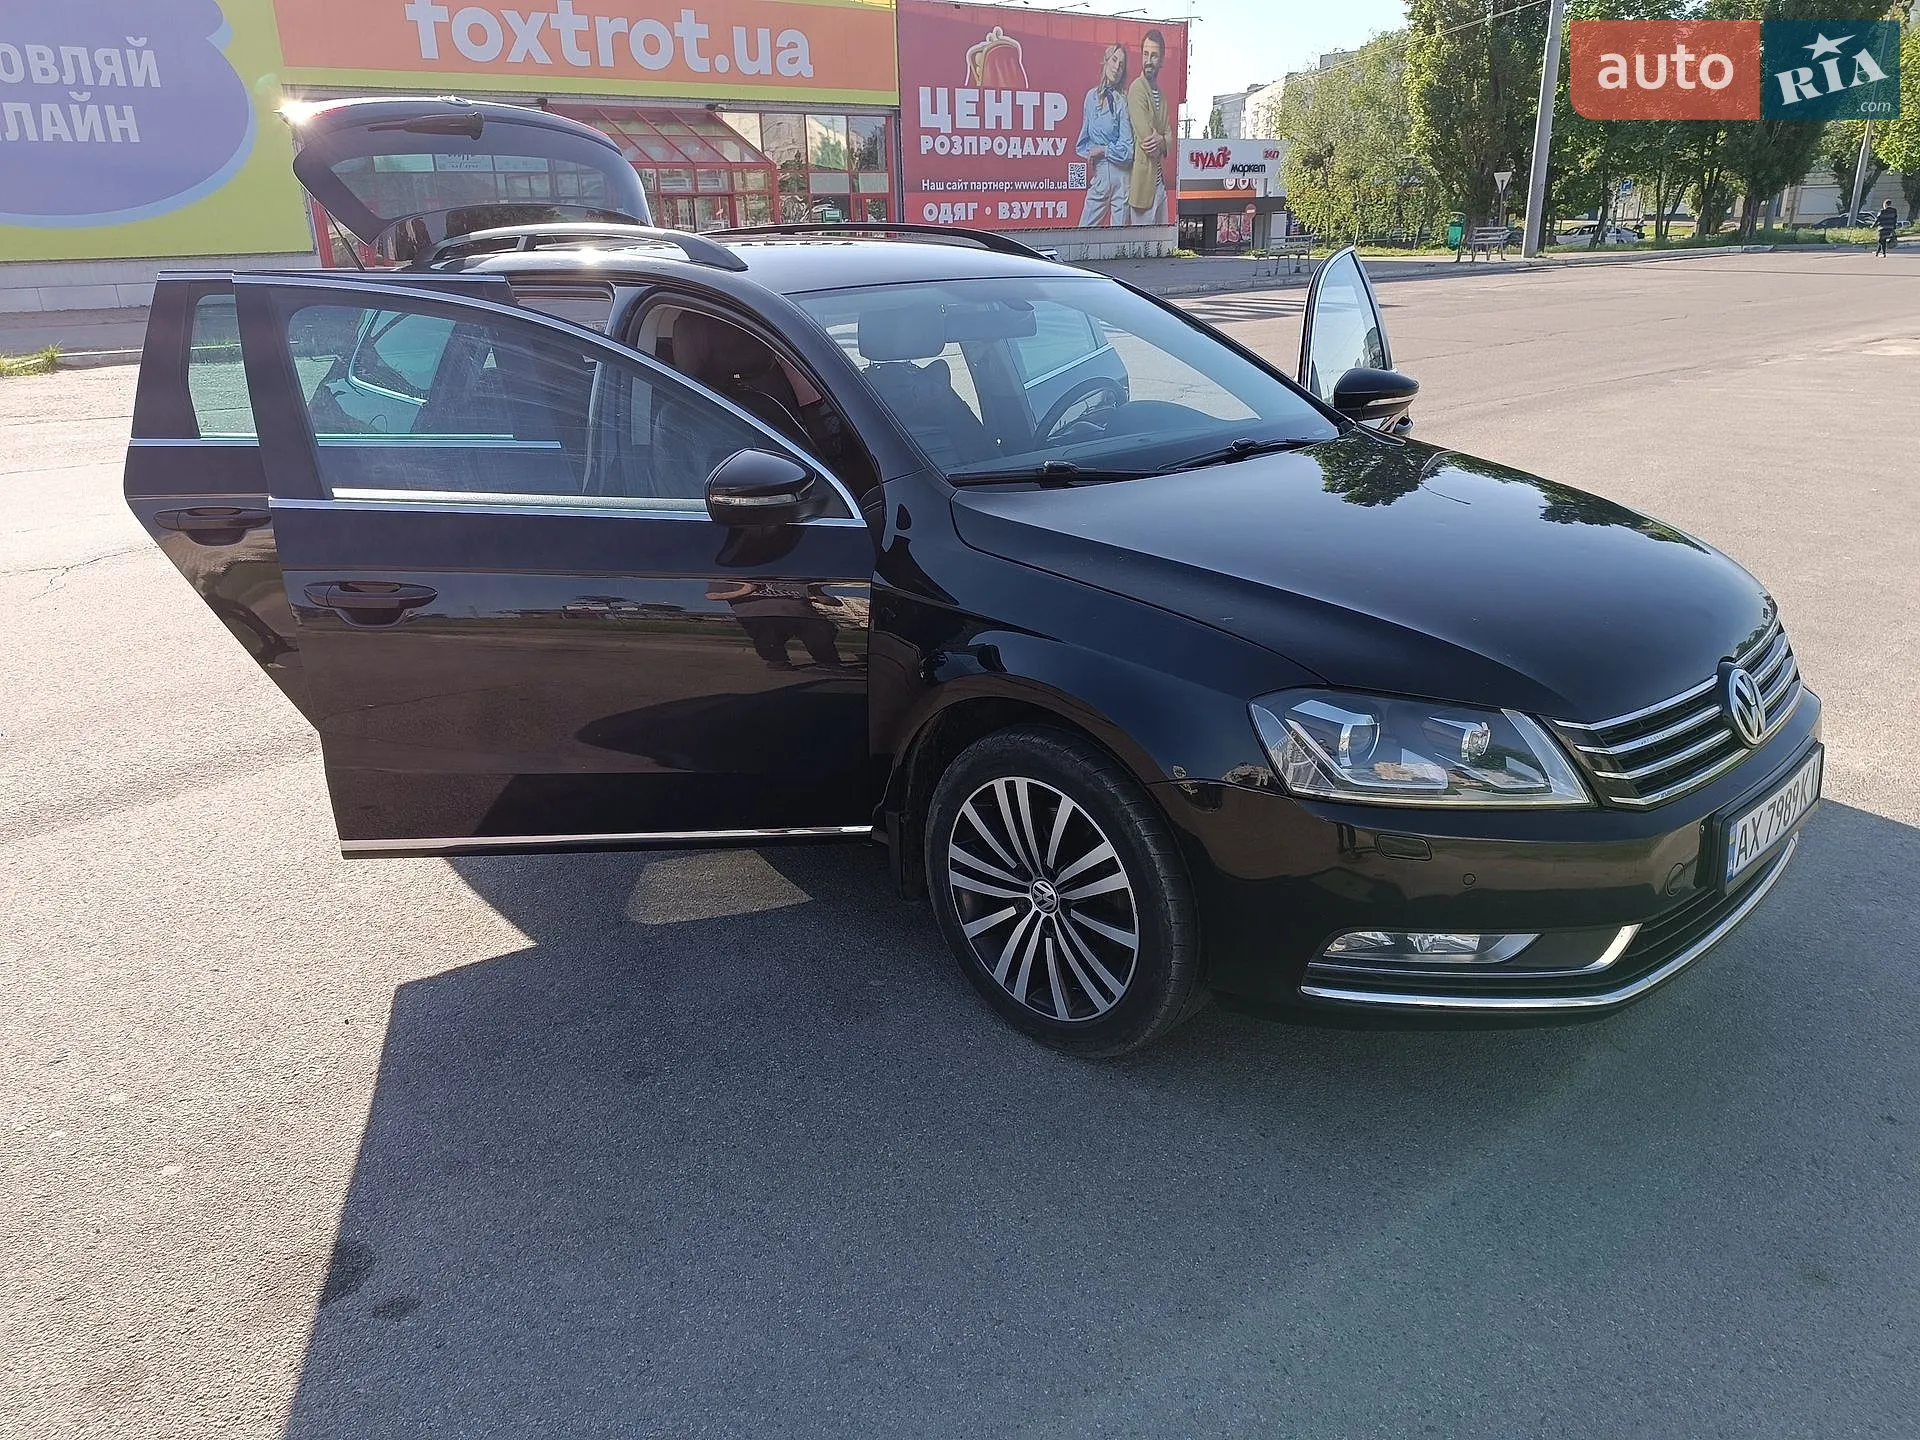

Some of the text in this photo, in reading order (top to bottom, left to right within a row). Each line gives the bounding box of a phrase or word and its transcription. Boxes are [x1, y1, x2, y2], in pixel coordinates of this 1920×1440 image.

[0, 91, 141, 143] ЛАЙН
[918, 86, 1068, 133] ЦЕНТР
[920, 135, 1067, 159] РОЗПРОДАЖУ
[1230, 163, 1266, 176] маркет
[922, 178, 1068, 193] Наш сайт партнер: www.olla.ua
[923, 201, 1068, 224] ОДЯГ ВЗУТТЯ
[1765, 781, 1799, 844] 7989
